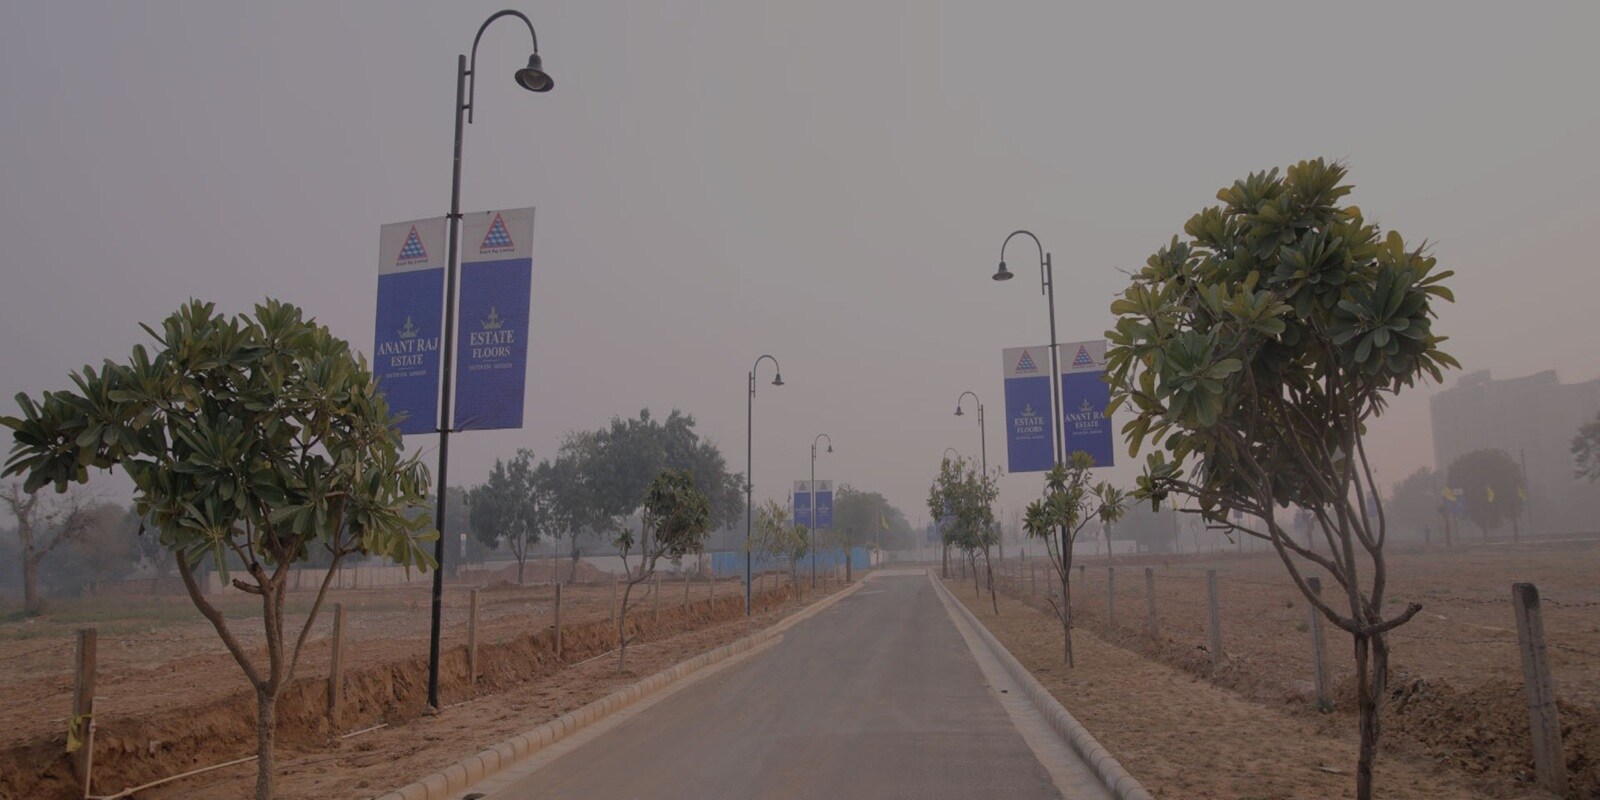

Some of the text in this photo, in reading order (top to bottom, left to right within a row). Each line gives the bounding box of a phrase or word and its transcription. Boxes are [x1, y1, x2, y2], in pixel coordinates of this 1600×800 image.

[470, 329, 515, 346] ESTATE
[378, 337, 439, 356] ANANT RAJ
[472, 346, 510, 359] FLOORS
[391, 354, 423, 367] ESTATE
[1014, 416, 1044, 426] ESTATE
[1065, 411, 1105, 422] ANANT RA
[1017, 426, 1042, 434] FLOORS
[1075, 420, 1099, 429] ESTATE
